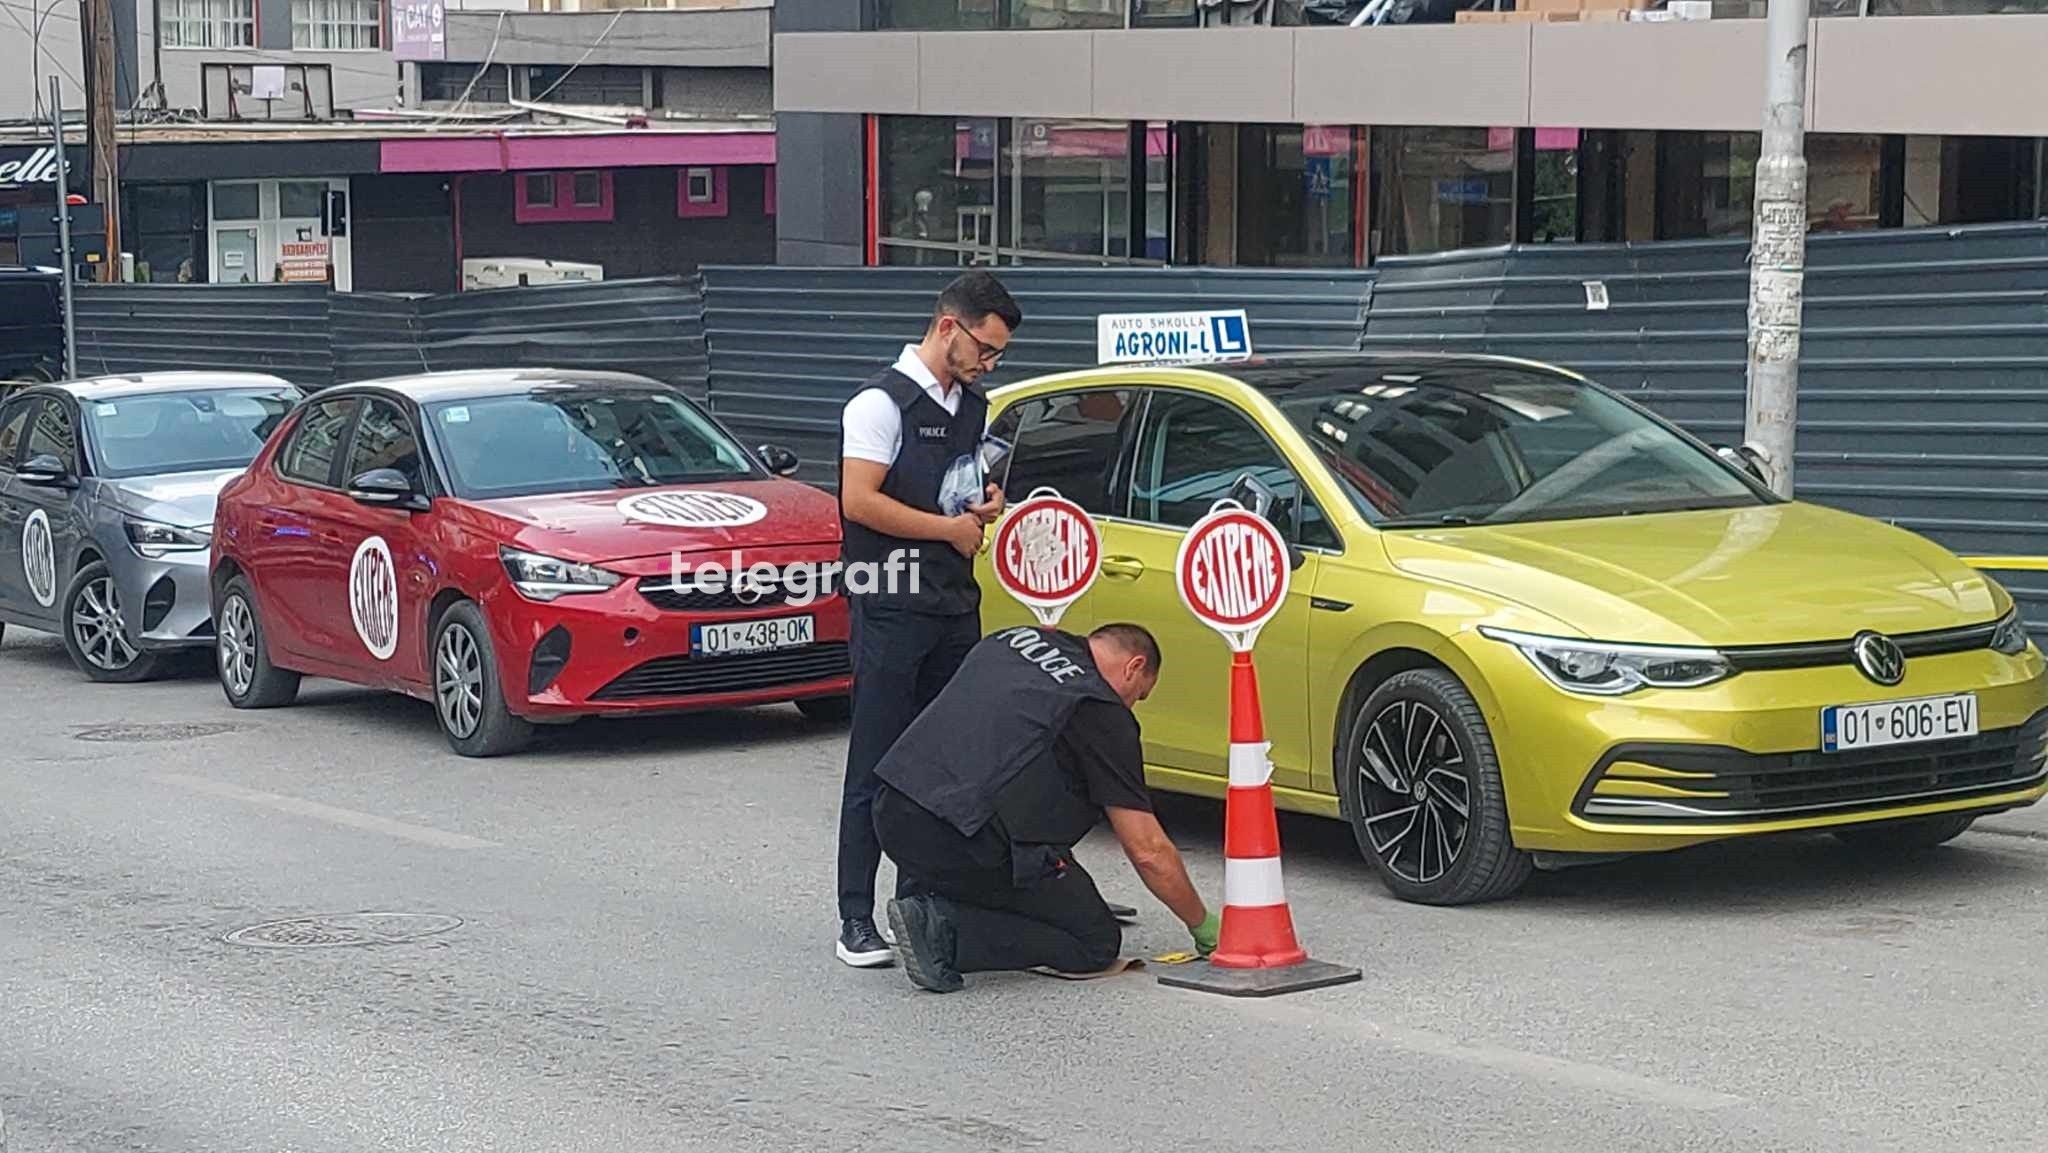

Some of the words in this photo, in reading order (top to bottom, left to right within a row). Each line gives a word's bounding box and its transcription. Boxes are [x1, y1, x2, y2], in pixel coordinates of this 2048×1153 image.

[1111, 319, 1143, 329] AUTO
[1150, 316, 1206, 328] SHKOLLA
[1217, 319, 1241, 350] L
[1115, 330, 1210, 356] AGRONI-L
[1191, 522, 1279, 618] EXTREME
[997, 627, 1086, 684] POLICE
